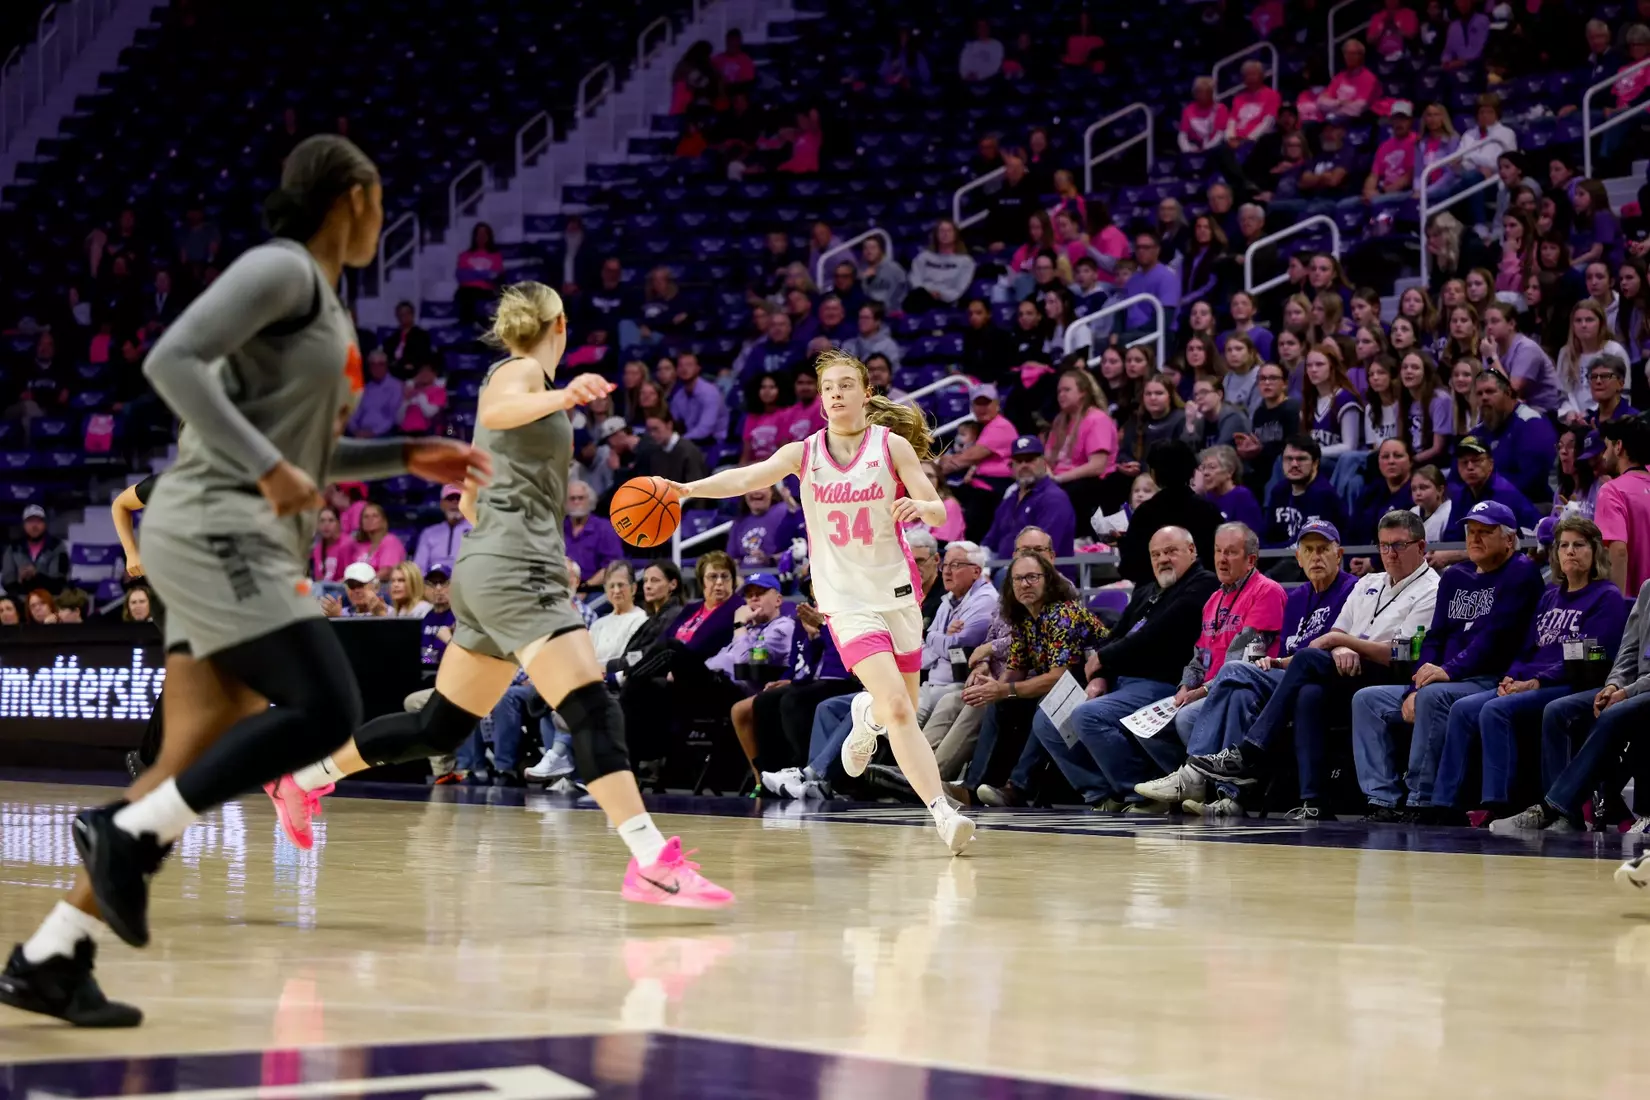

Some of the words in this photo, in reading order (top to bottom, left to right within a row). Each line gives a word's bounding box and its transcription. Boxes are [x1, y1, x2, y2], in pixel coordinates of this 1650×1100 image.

[812, 482, 886, 504] Wildcats
[827, 507, 874, 547] 34
[1330, 769, 1341, 779] 15
